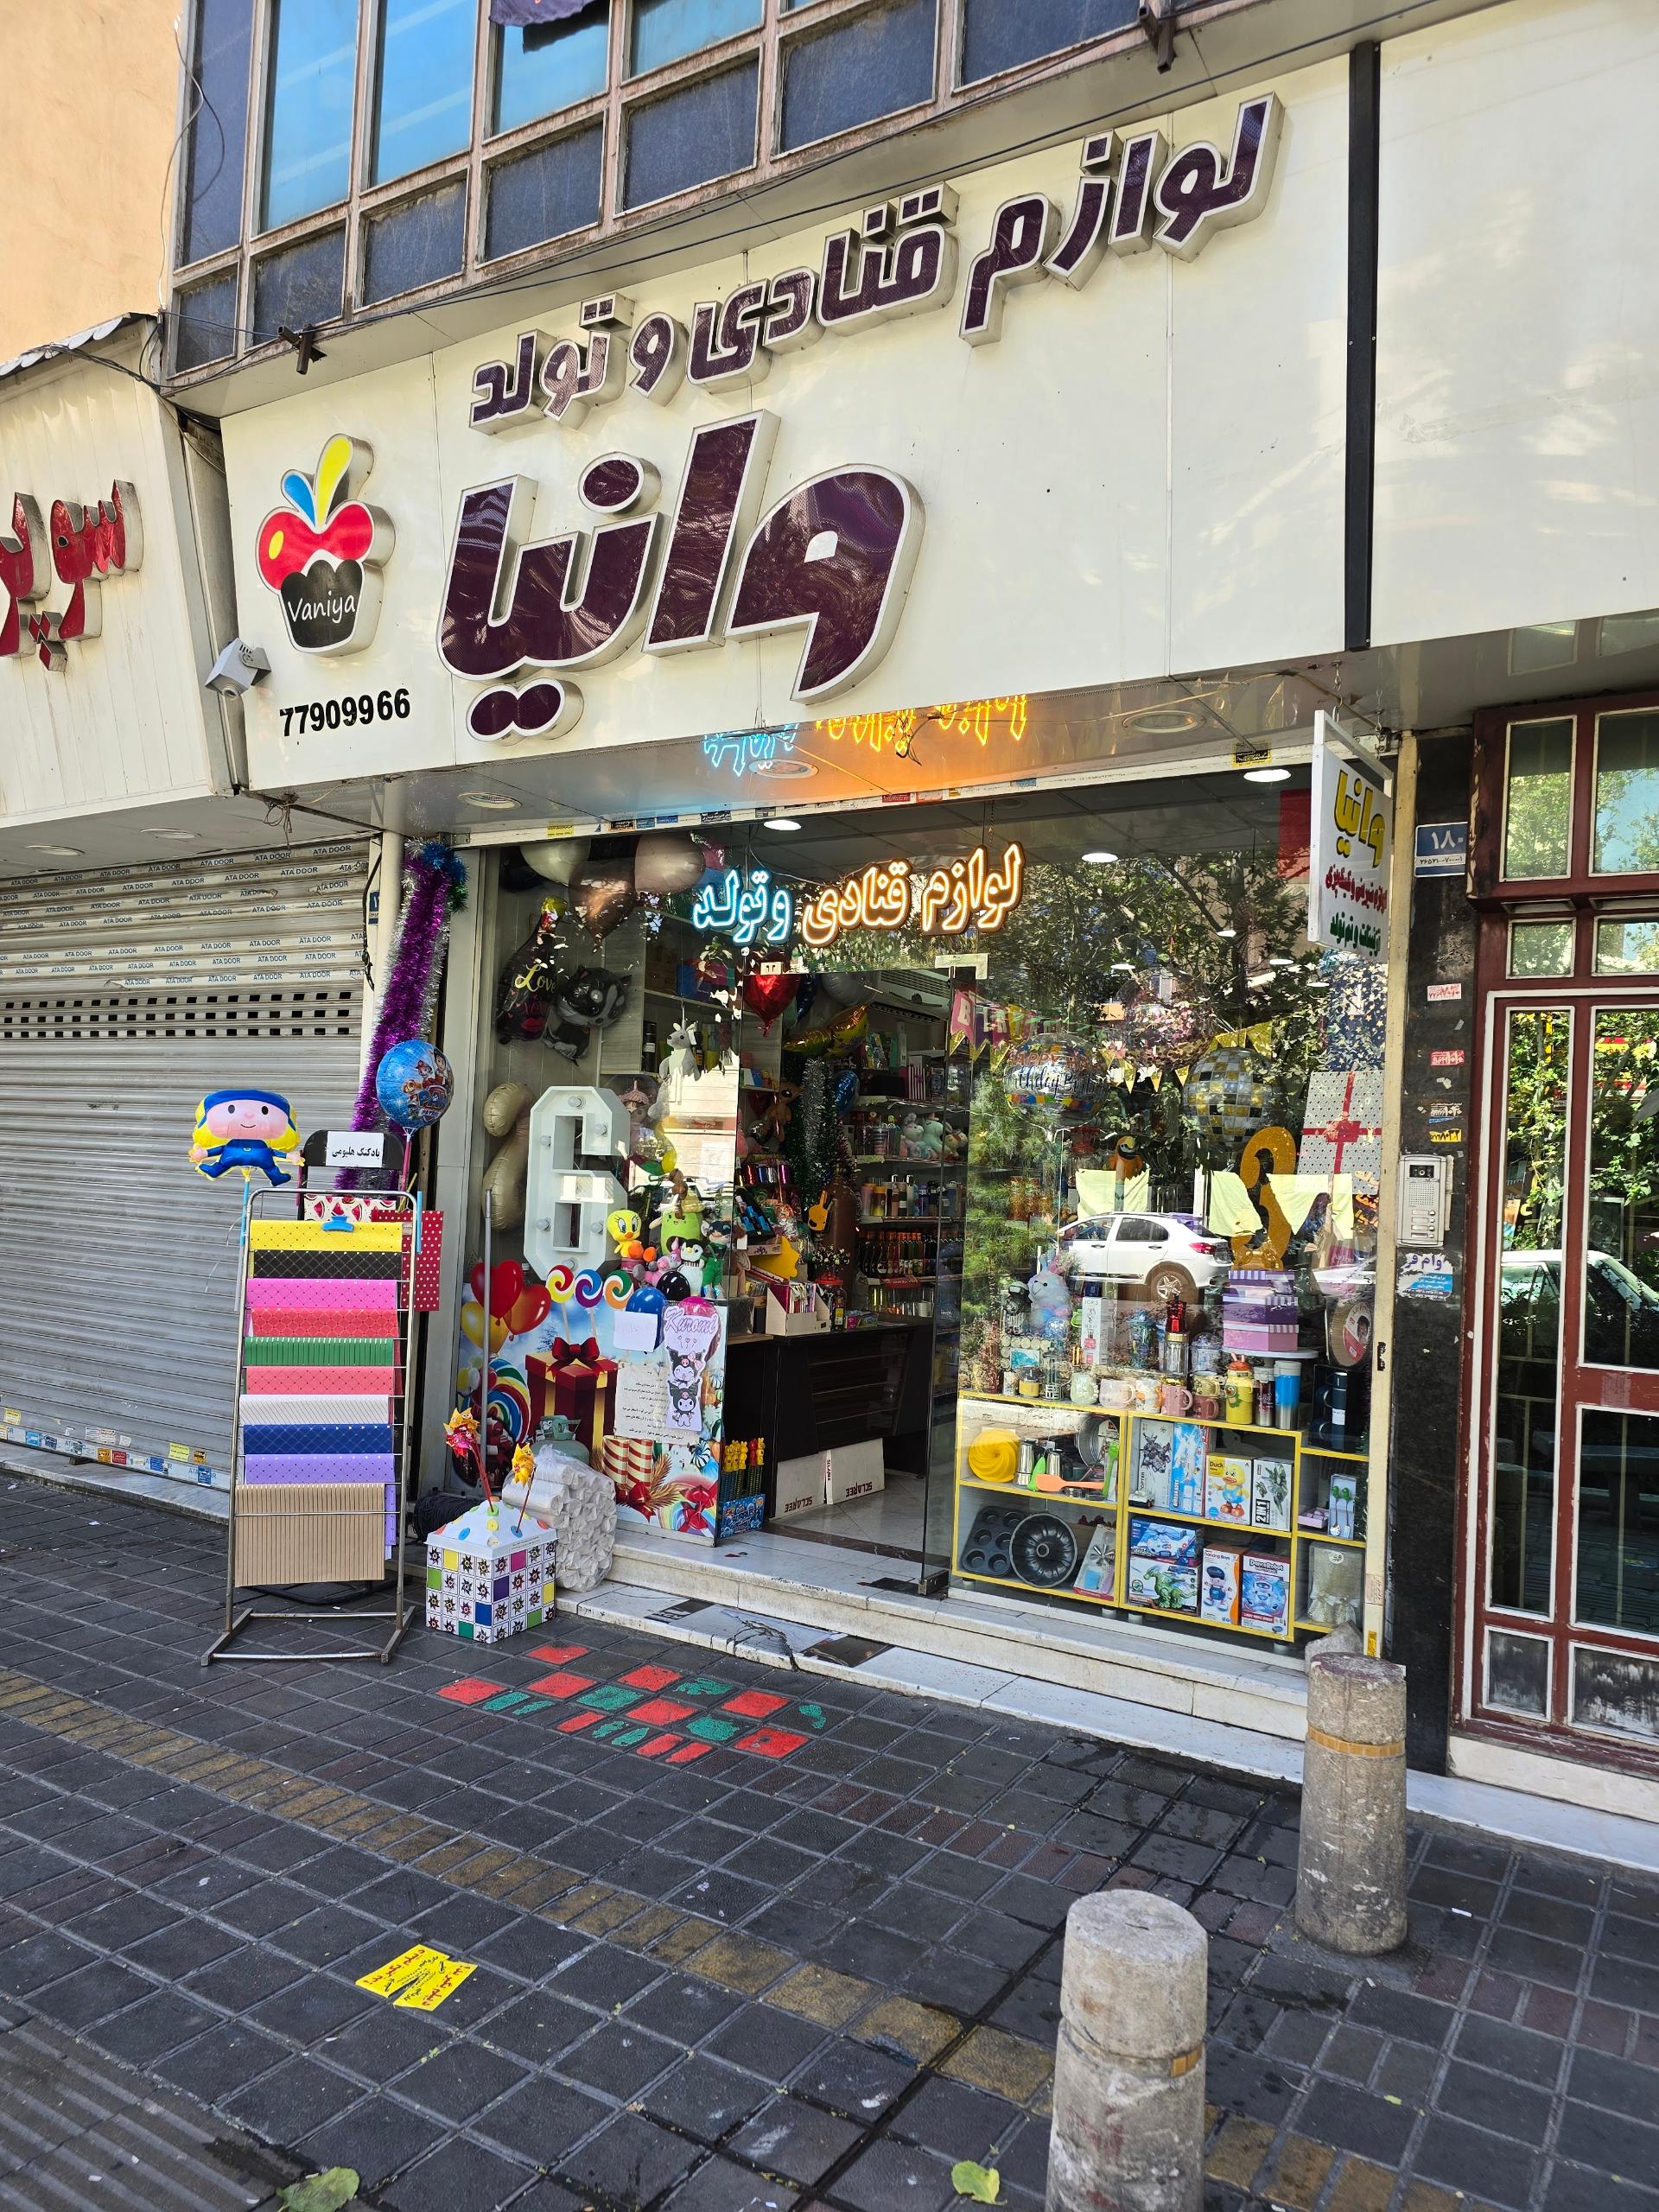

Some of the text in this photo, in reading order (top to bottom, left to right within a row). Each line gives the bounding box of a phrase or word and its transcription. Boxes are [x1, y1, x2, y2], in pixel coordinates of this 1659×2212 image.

[469, 92, 1276, 427] لوازم قنادی و تولد
[288, 590, 355, 624] Vaniya
[436, 410, 914, 743] وانیا
[279, 688, 410, 737] 77909966
[1334, 769, 1386, 869] وانیا
[802, 861, 909, 946] قنادی
[921, 841, 1023, 932] لوازم
[356, 1147, 380, 1160] بادکنک
[664, 1306, 718, 1334] Kuromi
